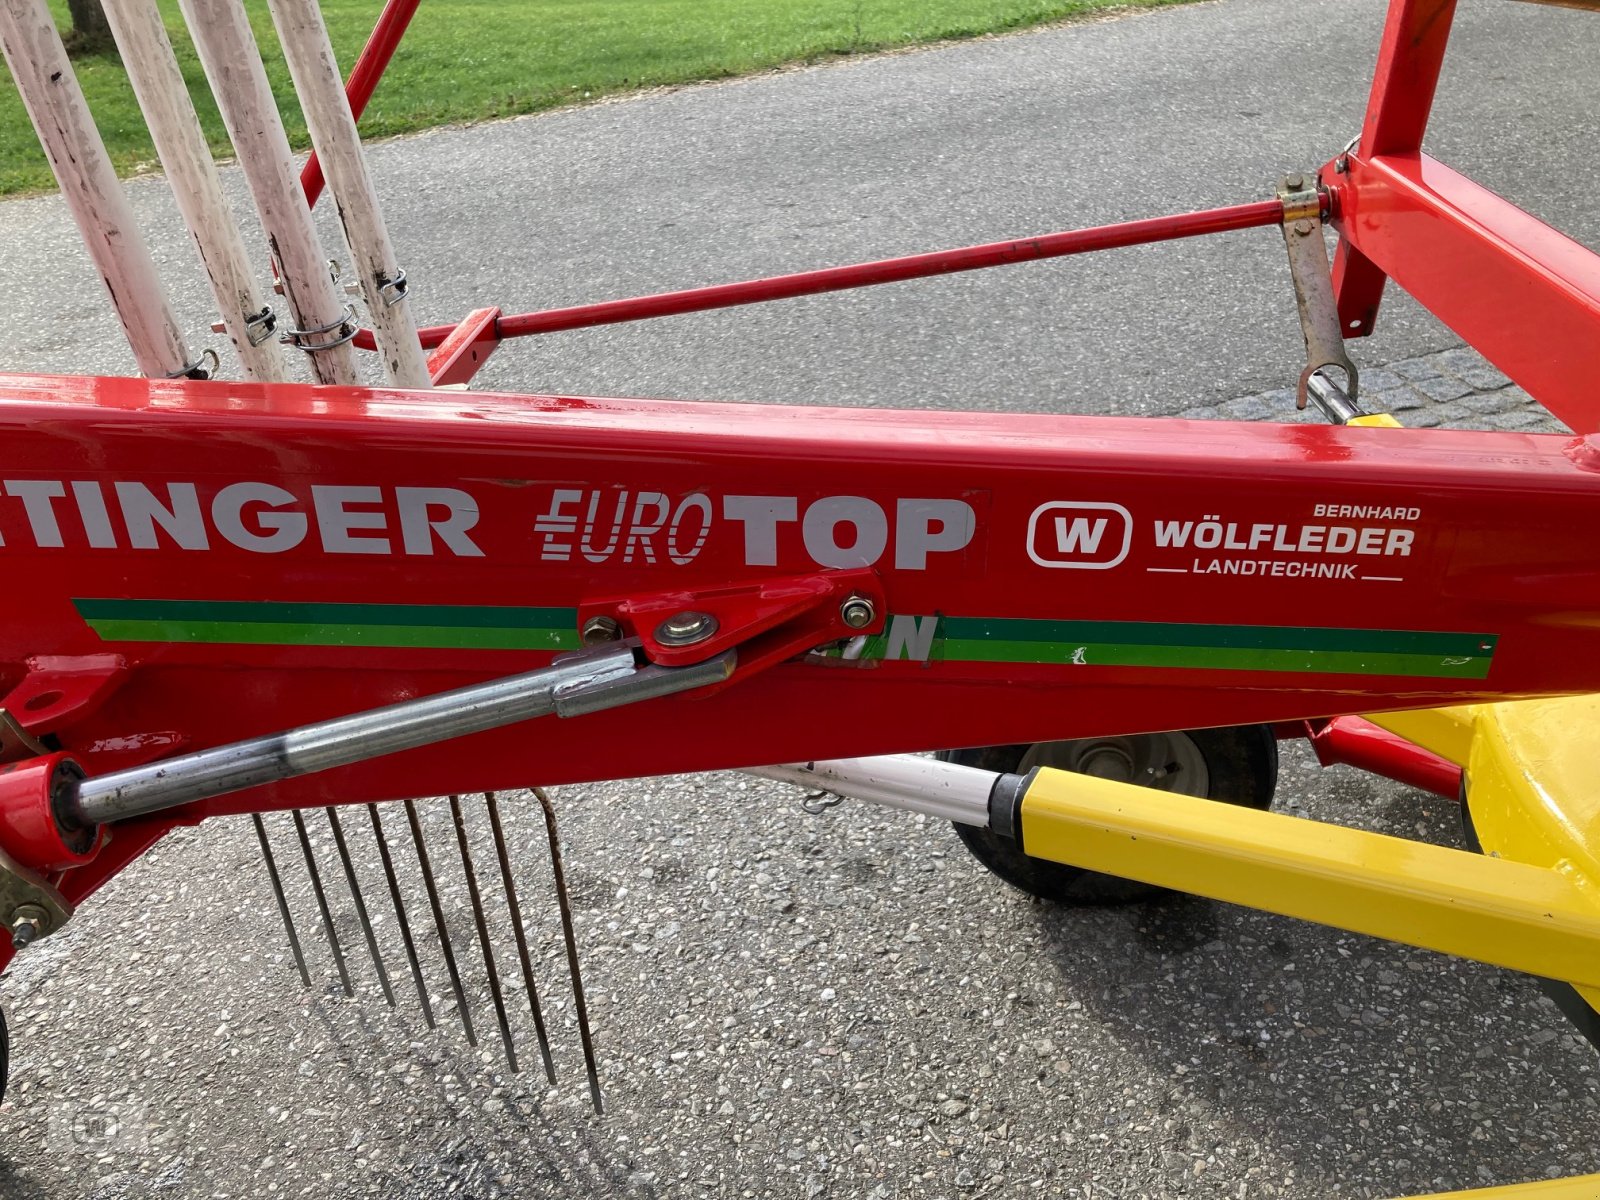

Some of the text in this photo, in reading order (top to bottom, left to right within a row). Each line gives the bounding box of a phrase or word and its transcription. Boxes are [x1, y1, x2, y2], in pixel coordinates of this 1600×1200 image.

[0, 480, 485, 556] TINGER
[1314, 504, 1421, 520] BERNHARD
[1054, 516, 1108, 554] W
[1154, 514, 1415, 556] WÖLFLEDER
[1193, 558, 1358, 580] LANDTECHNIK
